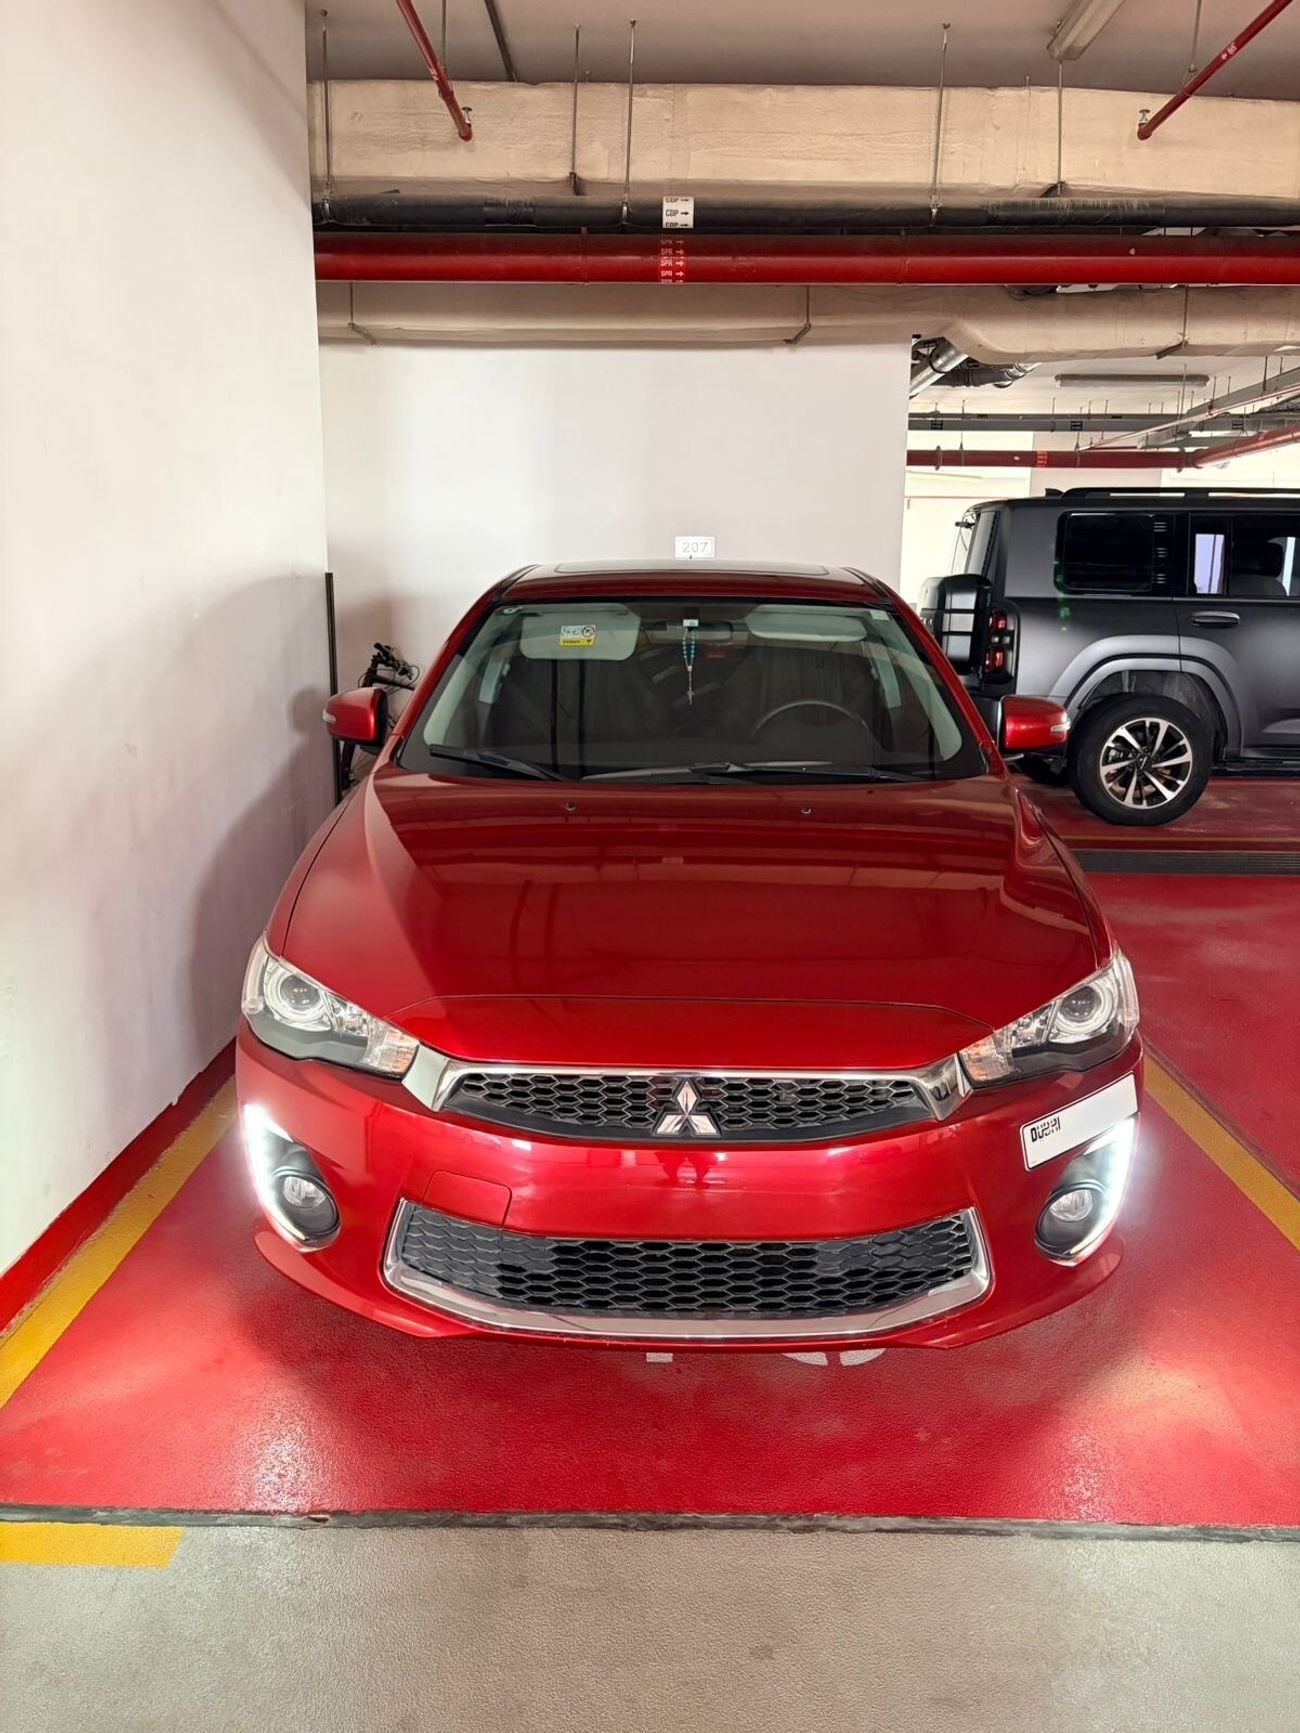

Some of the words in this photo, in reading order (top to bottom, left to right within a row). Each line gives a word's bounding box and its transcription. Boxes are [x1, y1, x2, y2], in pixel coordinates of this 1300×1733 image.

[665, 209, 680, 217] CDP
[681, 541, 708, 553] 207
[1030, 1116, 1061, 1143] DUBAI
